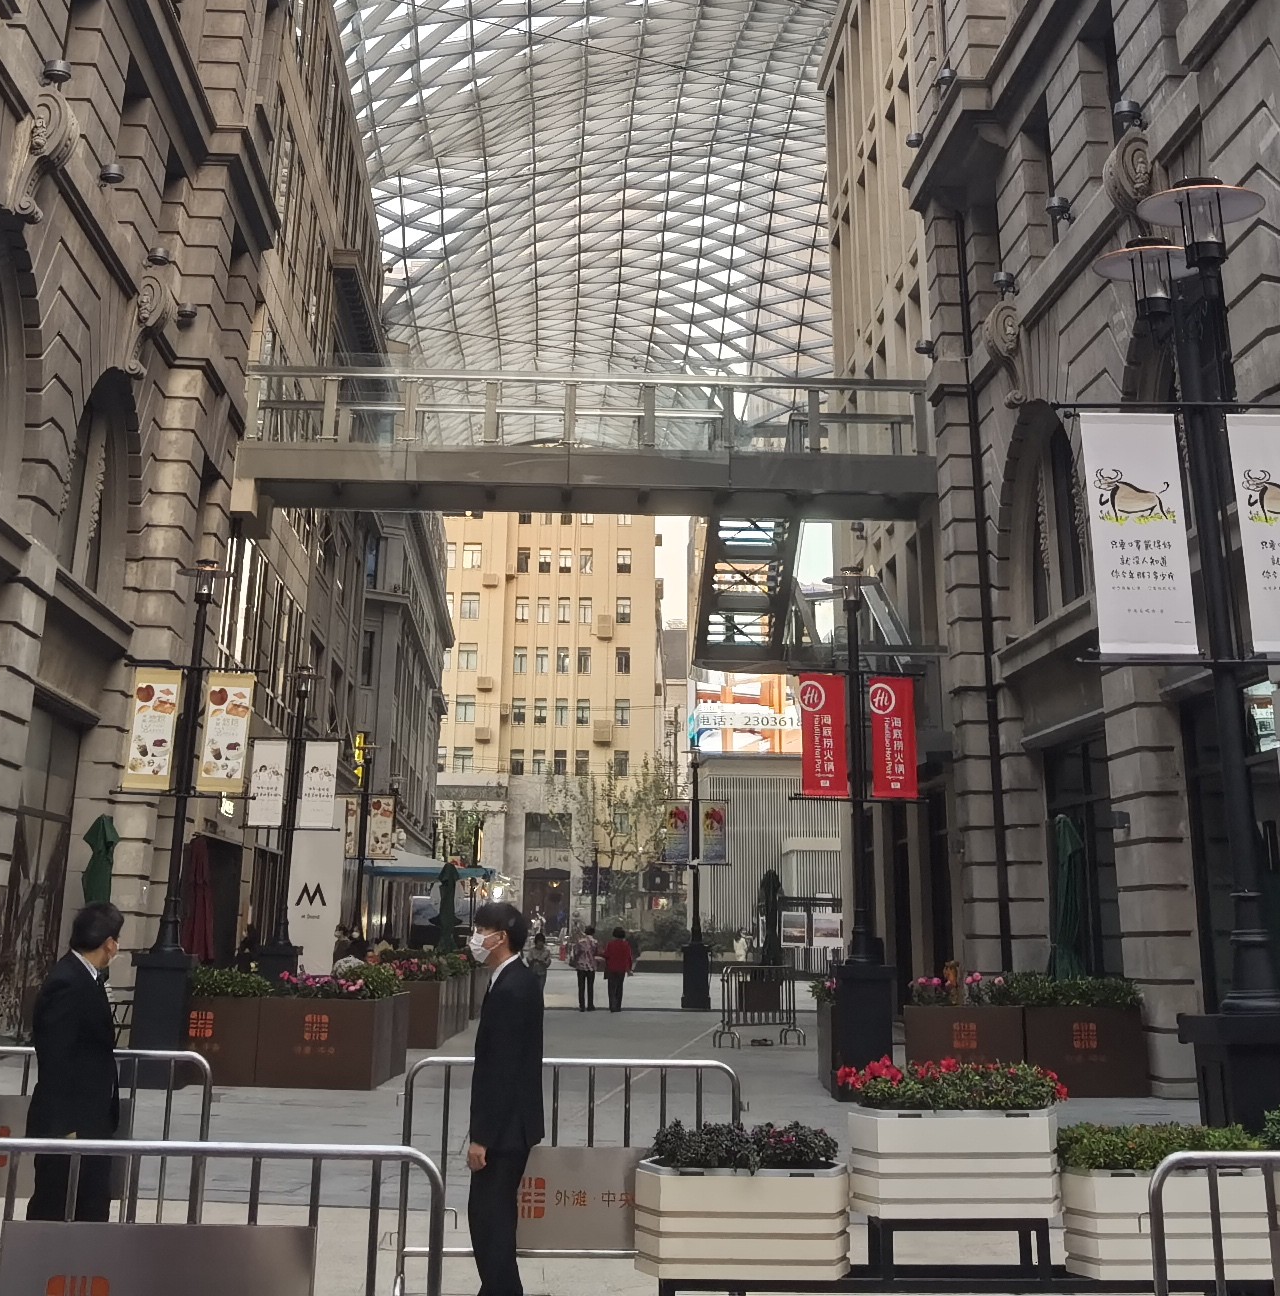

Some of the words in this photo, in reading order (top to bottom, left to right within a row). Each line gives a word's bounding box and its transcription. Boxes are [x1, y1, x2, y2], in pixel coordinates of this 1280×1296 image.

[1119, 555, 1167, 567] 就没人知道
[821, 714, 835, 772] 海底捞火锅
[891, 717, 905, 775] 海底捞火锅
[294, 882, 327, 906] M
